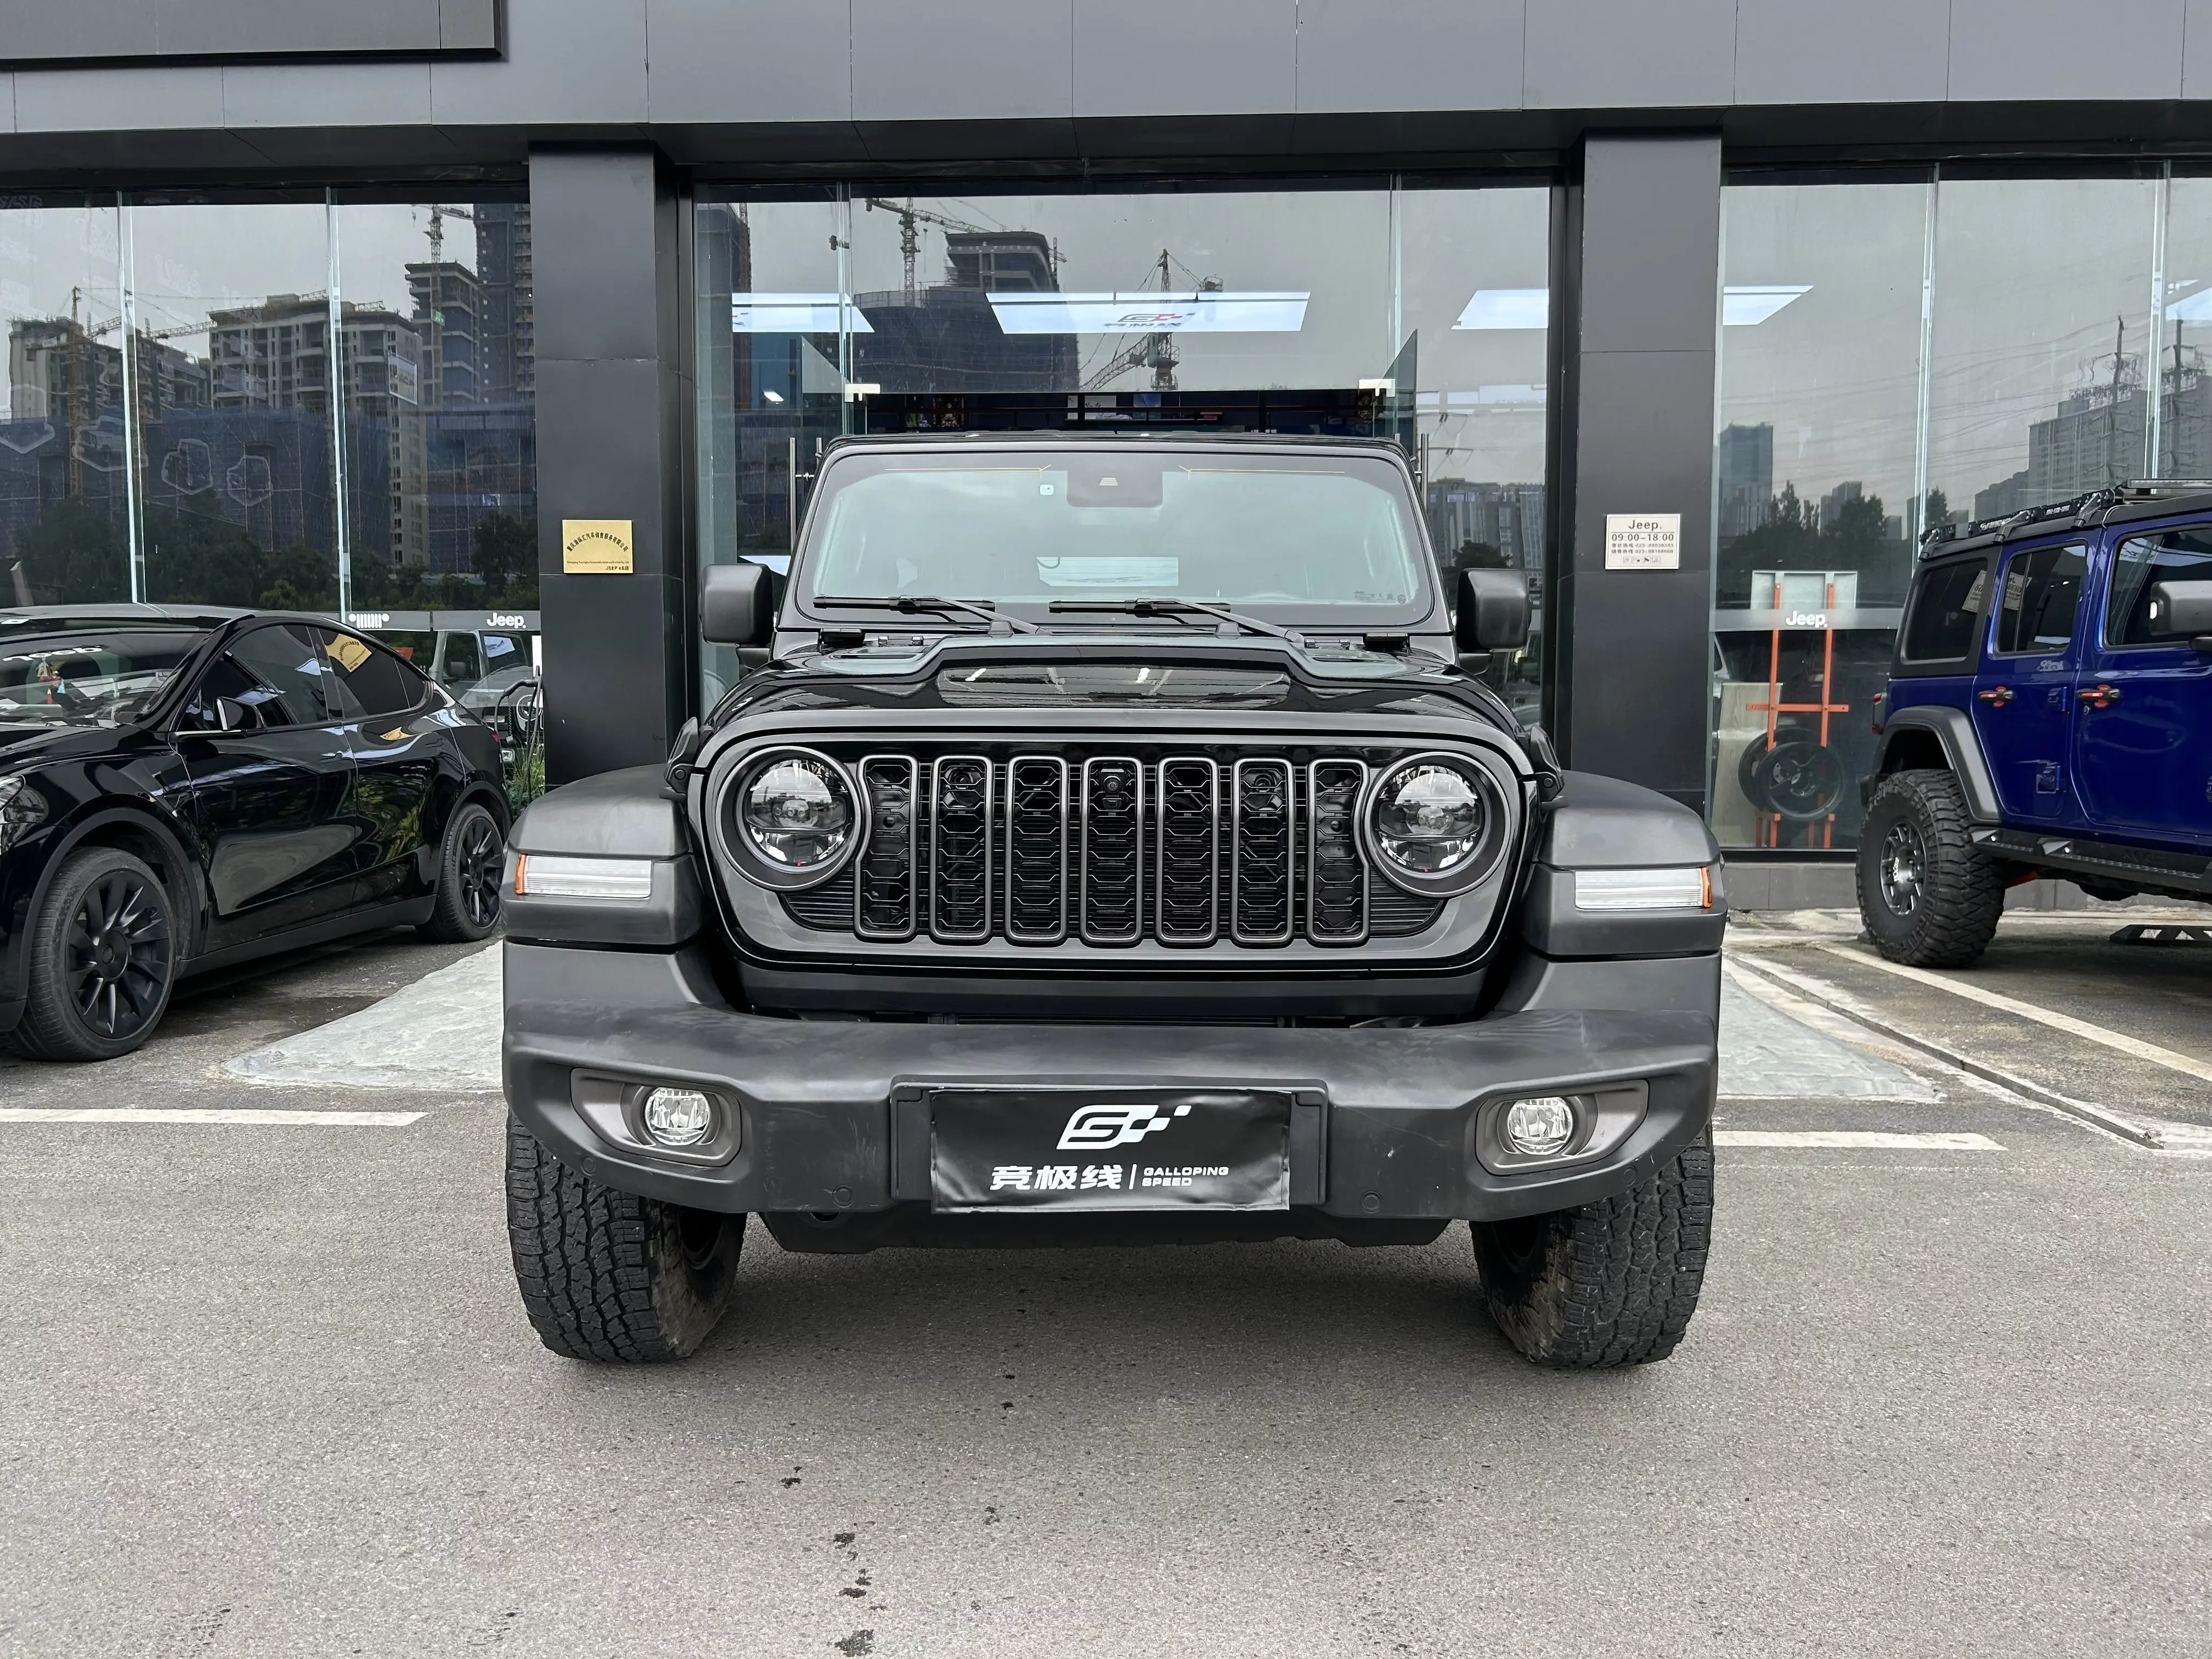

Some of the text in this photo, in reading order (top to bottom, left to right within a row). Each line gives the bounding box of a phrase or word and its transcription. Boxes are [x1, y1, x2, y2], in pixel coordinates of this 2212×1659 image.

[1143, 1166, 1229, 1176] GALLOPING
[990, 1164, 1123, 1190] 竞极线
[1141, 1177, 1193, 1187] SPEED
